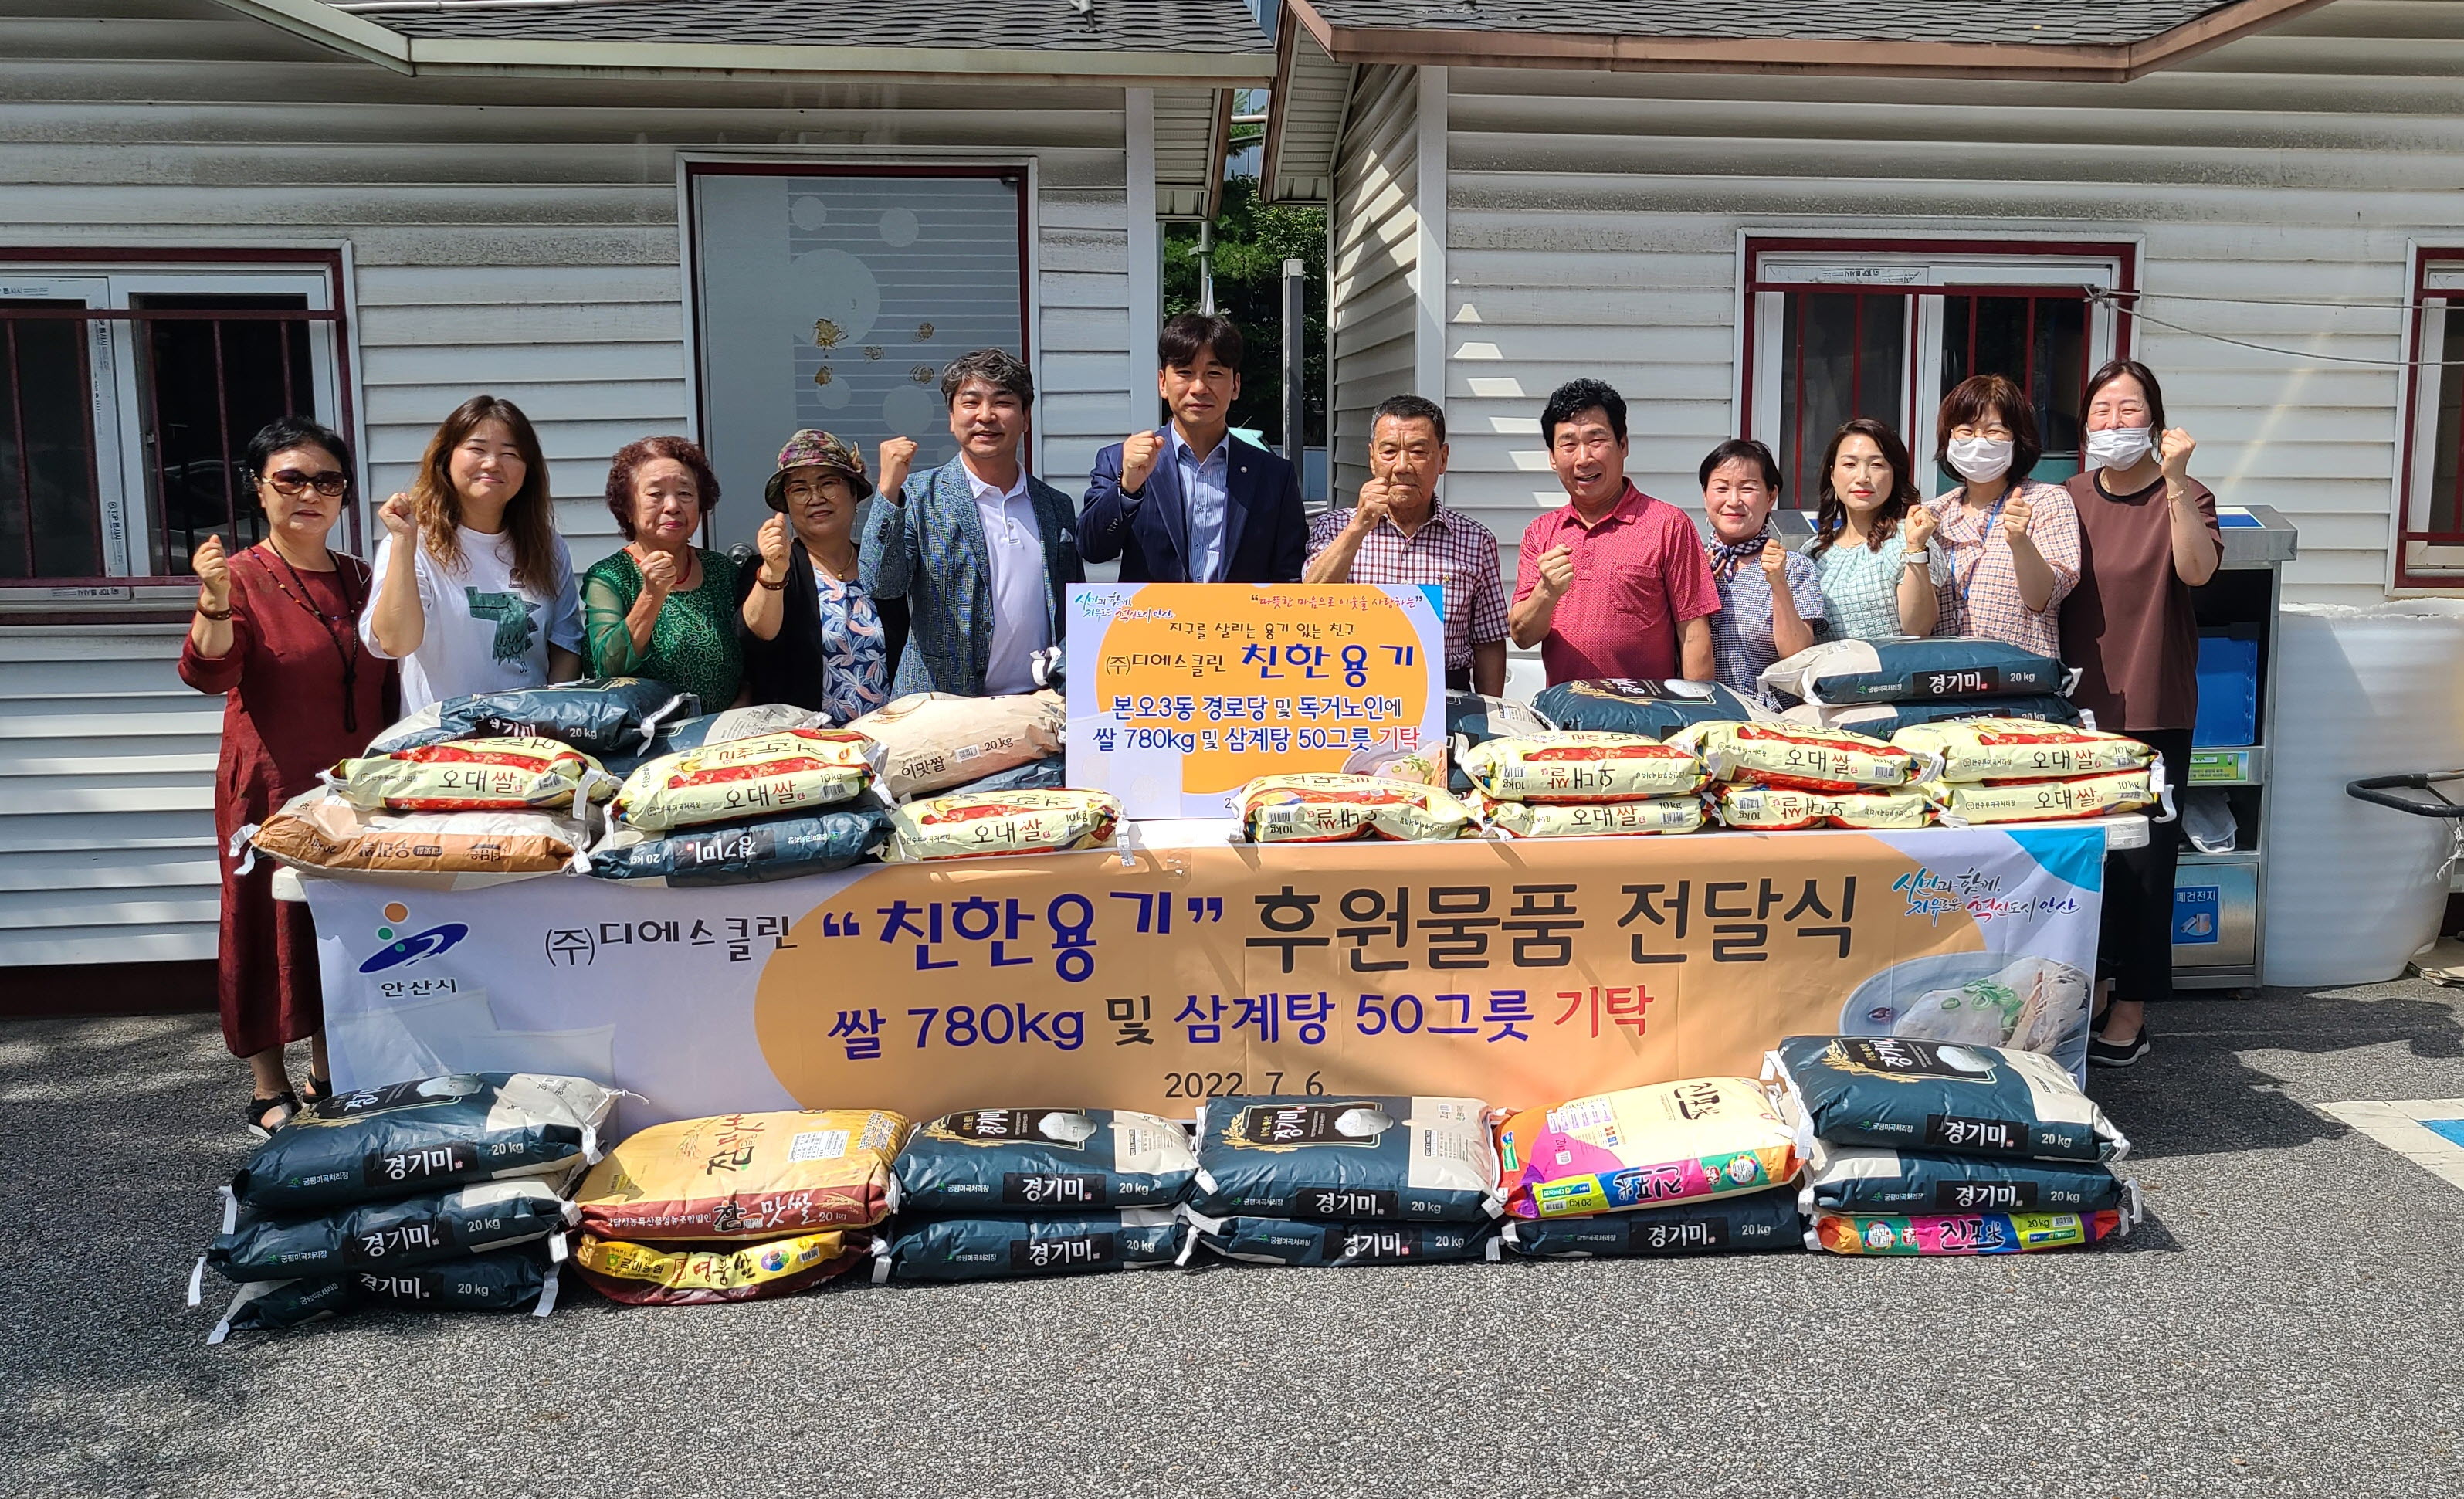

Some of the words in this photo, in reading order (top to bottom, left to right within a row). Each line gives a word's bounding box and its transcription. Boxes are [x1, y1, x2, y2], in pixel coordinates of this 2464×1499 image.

[1297, 596, 1337, 609] 마음으로
[1339, 595, 1369, 611] 이웃을
[1169, 622, 1206, 640] 지구를
[1215, 622, 1256, 639] 살리는
[1265, 623, 1289, 640] 용기
[1296, 623, 1321, 639] 있는
[1330, 623, 1354, 637] 친구
[1928, 671, 1981, 694] 경기미
[2010, 672, 2022, 682] 20
[2023, 672, 2035, 683] kg
[1111, 696, 1195, 721] 본오3동
[1202, 696, 1268, 721] 경로당
[1275, 697, 1292, 718] 및
[1297, 696, 1401, 721] 독거노인에
[569, 727, 582, 738] 20
[585, 727, 598, 739] kg
[1093, 727, 1118, 752] 쌀
[1126, 727, 1195, 754] 780kg
[1201, 730, 1218, 751] 및
[1224, 727, 1292, 752] 삼계탕
[1297, 727, 1372, 752] 50그릇
[1377, 727, 1421, 752] 기탁
[901, 755, 947, 780] 이맛쌀
[985, 741, 998, 751] 20
[998, 737, 1014, 748] kg
[1785, 748, 1855, 775] 오대쌀
[2030, 748, 2095, 771] 오대쌀
[438, 768, 517, 794] 오대쌀
[1547, 766, 1616, 789] 오대쌀
[724, 779, 797, 810] 오대쌀
[2033, 787, 2097, 810] 오대쌀
[1571, 805, 1638, 827] 오대쌀
[1781, 796, 1847, 819] 오대쌀
[971, 818, 1042, 844] 오대쌀
[629, 853, 644, 865] kg
[646, 853, 660, 864] 20
[696, 836, 757, 863] 경기미
[2176, 890, 2216, 903] 폐건전지
[1904, 897, 1964, 927] 자유로운
[1965, 895, 2038, 924] 혁신도시
[2039, 896, 2082, 915] 안산
[1245, 883, 1585, 975] 후원물품
[1617, 874, 1858, 965] 전달식
[381, 977, 458, 998] 안산시
[827, 1007, 887, 1060] 쌀
[907, 1002, 1086, 1051] 780kg
[1106, 994, 1154, 1046] 및
[1173, 990, 1337, 1046] 삼계탕
[1356, 988, 1535, 1043] 50그릇
[1554, 984, 1655, 1039] 기탁
[1870, 1038, 1910, 1069] 경기미
[975, 1109, 1009, 1136] 경기미
[1273, 1107, 1307, 1141] 경기미
[1944, 1121, 2007, 1148] 경기미
[2041, 1133, 2056, 1145] 20
[2056, 1134, 2073, 1148] kg
[385, 1147, 454, 1180] 경기미
[491, 1143, 506, 1157] 20
[507, 1141, 524, 1157] kg
[1022, 1178, 1084, 1202] 경기미
[1119, 1182, 1133, 1194] 20
[1134, 1182, 1149, 1195] kg
[1954, 1185, 2016, 1208] 경기미
[2050, 1191, 2064, 1202] 20
[2066, 1191, 2080, 1204] kg
[1315, 1192, 1377, 1216] 경기미
[1412, 1201, 1425, 1212] 20
[1427, 1201, 1442, 1214] kg
[1568, 1198, 1581, 1209] kg
[1581, 1199, 1592, 1208] 20
[819, 1211, 832, 1223] 20
[835, 1212, 847, 1222] kg
[2027, 1219, 2039, 1228] 20
[2039, 1219, 2050, 1228] kg
[361, 1224, 431, 1257] 경기미
[467, 1219, 483, 1233] 20
[484, 1218, 501, 1233] kg
[1342, 1233, 1401, 1257] 경기미
[1435, 1236, 1449, 1247] 20
[1450, 1236, 1465, 1249] kg
[1647, 1223, 1708, 1248] 경기미
[1741, 1224, 1755, 1236] 20
[1757, 1224, 1771, 1236] kg
[1029, 1240, 1092, 1267] 경기미
[1126, 1240, 1140, 1252] 20
[1141, 1240, 1156, 1253] kg
[457, 1283, 473, 1295] 20
[474, 1282, 490, 1298] kg
